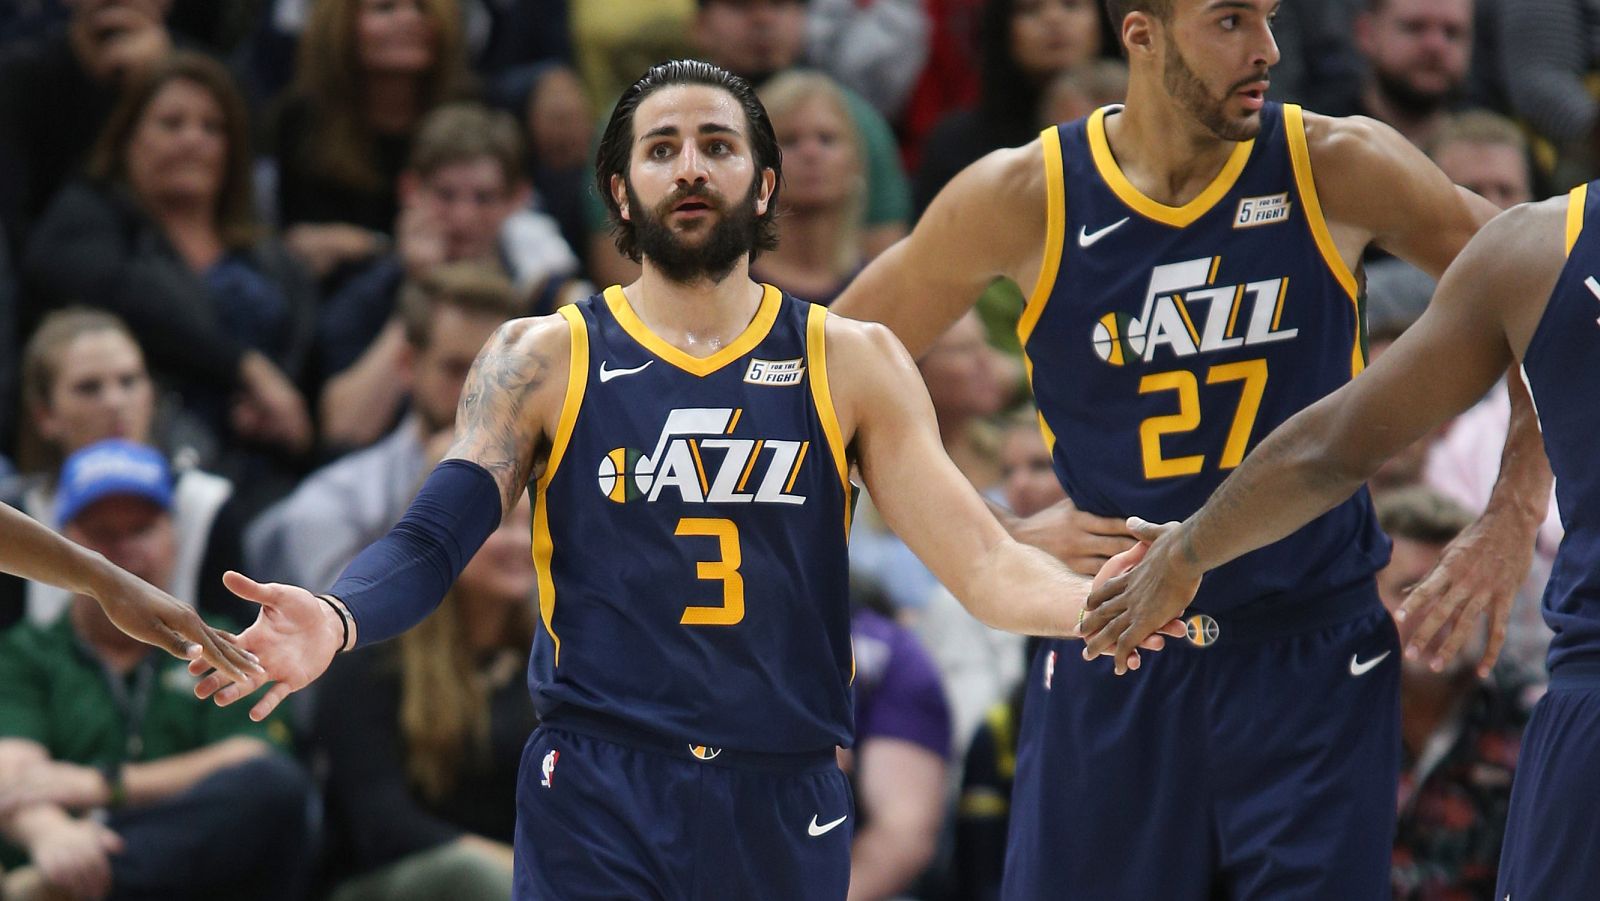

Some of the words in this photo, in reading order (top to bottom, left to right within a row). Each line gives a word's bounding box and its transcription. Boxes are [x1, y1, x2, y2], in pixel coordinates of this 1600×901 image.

[1240, 202, 1253, 223] 5
[1255, 207, 1286, 221] FIGHT
[750, 363, 765, 380] 5
[766, 372, 799, 382] FIGHT
[1138, 357, 1269, 480] 27
[673, 517, 746, 626] 3
